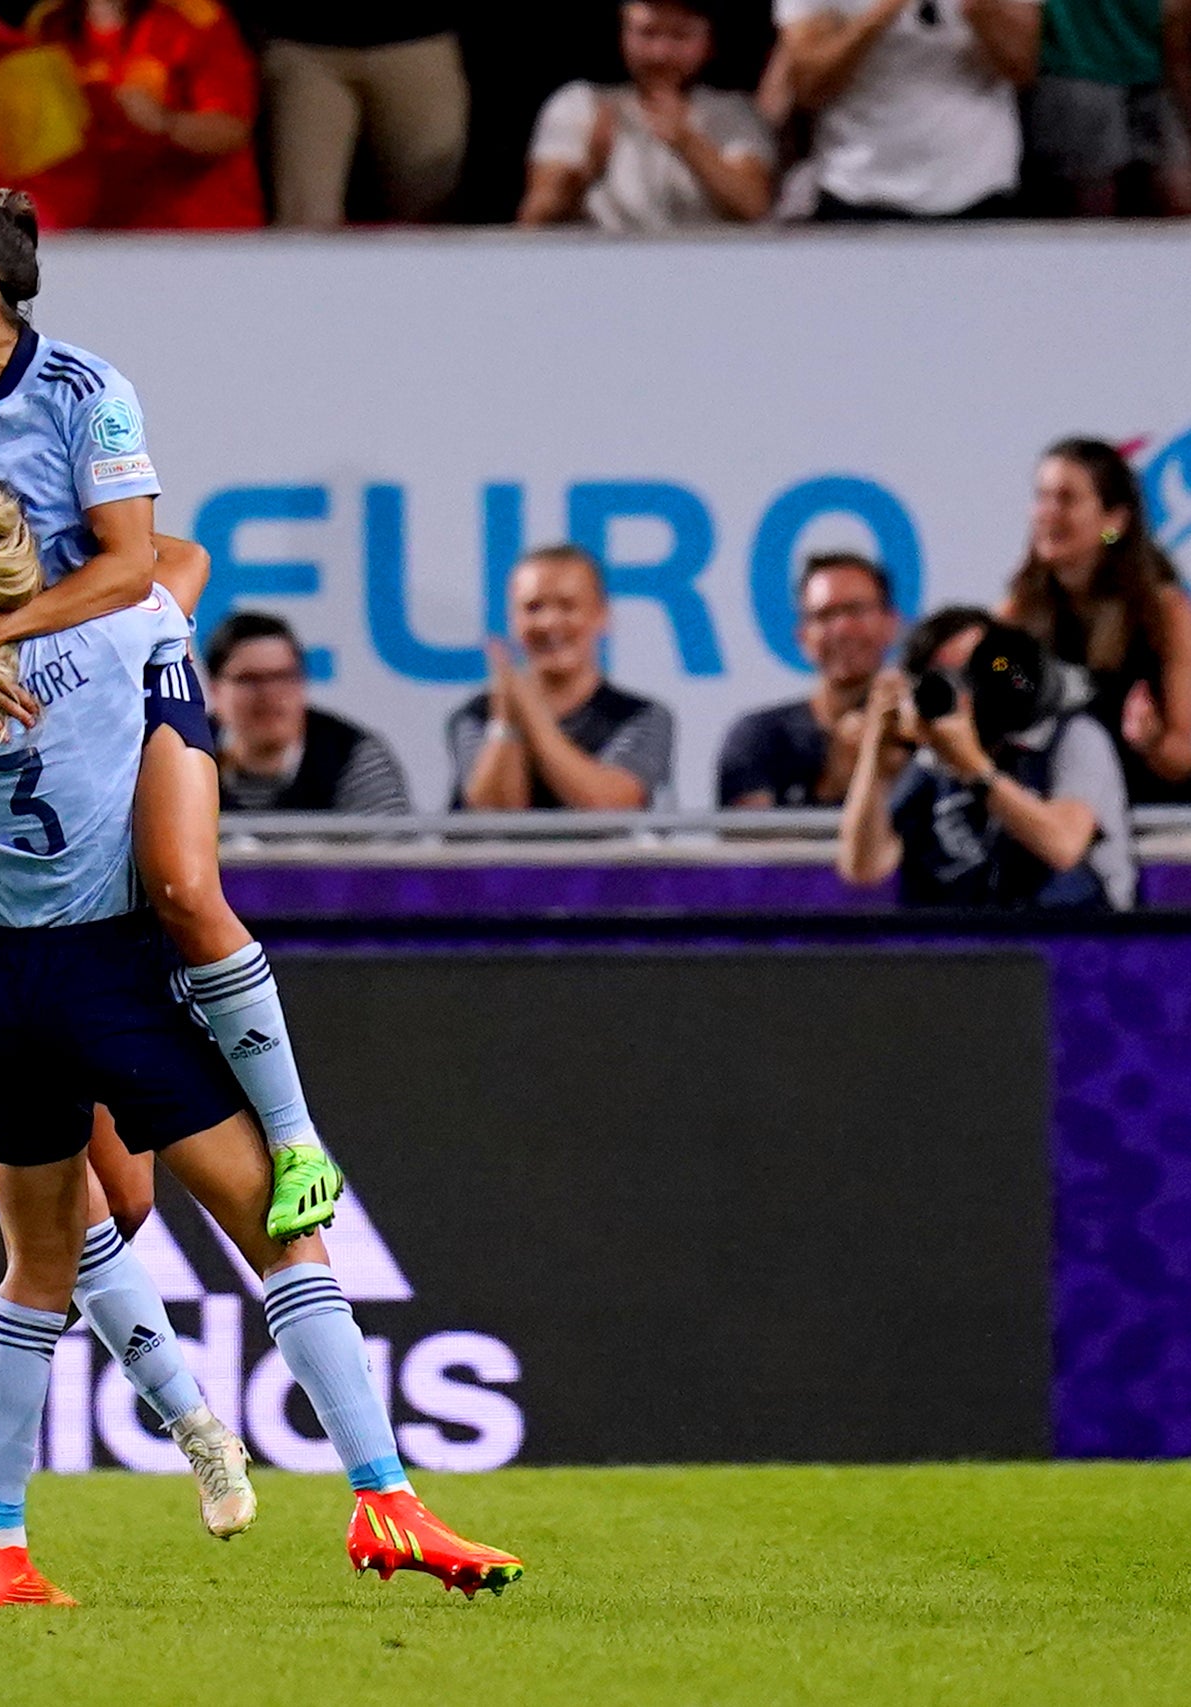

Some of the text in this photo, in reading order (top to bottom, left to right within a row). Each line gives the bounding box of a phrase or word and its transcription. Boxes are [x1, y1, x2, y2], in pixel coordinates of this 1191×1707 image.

[193, 475, 924, 684] EURO
[229, 1037, 281, 1060] adidas
[123, 1333, 166, 1367] adidas
